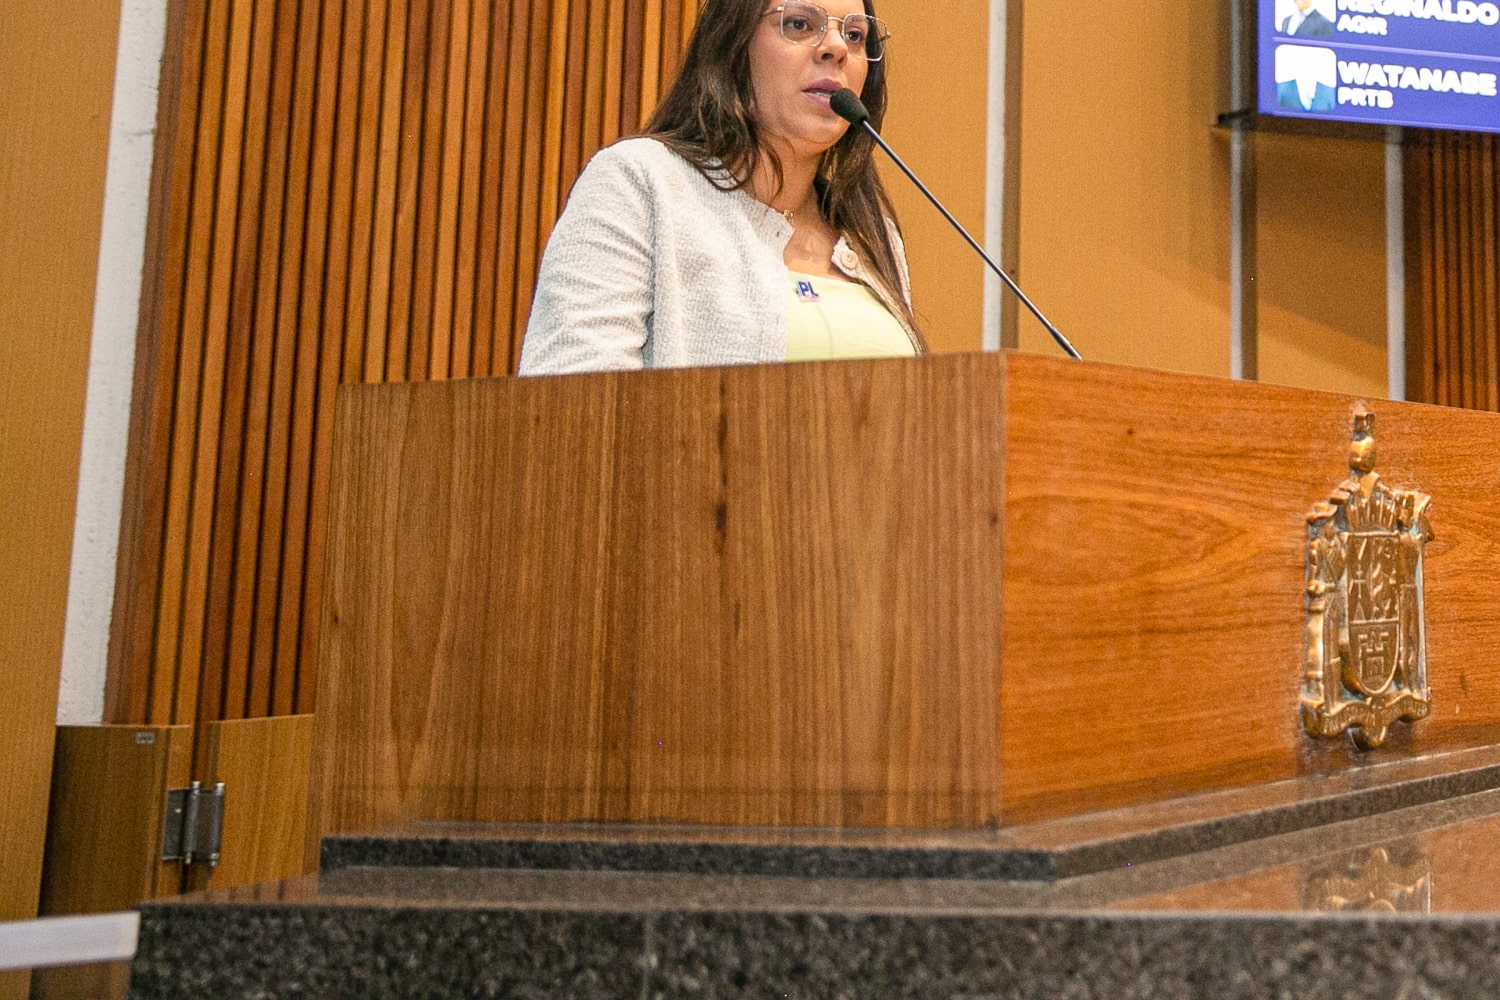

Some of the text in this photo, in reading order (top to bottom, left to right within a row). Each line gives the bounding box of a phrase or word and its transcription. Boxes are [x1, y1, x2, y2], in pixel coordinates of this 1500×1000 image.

[1337, 60, 1497, 96] WATANABE
[1338, 86, 1394, 108] PRTB
[798, 281, 819, 297] PL
